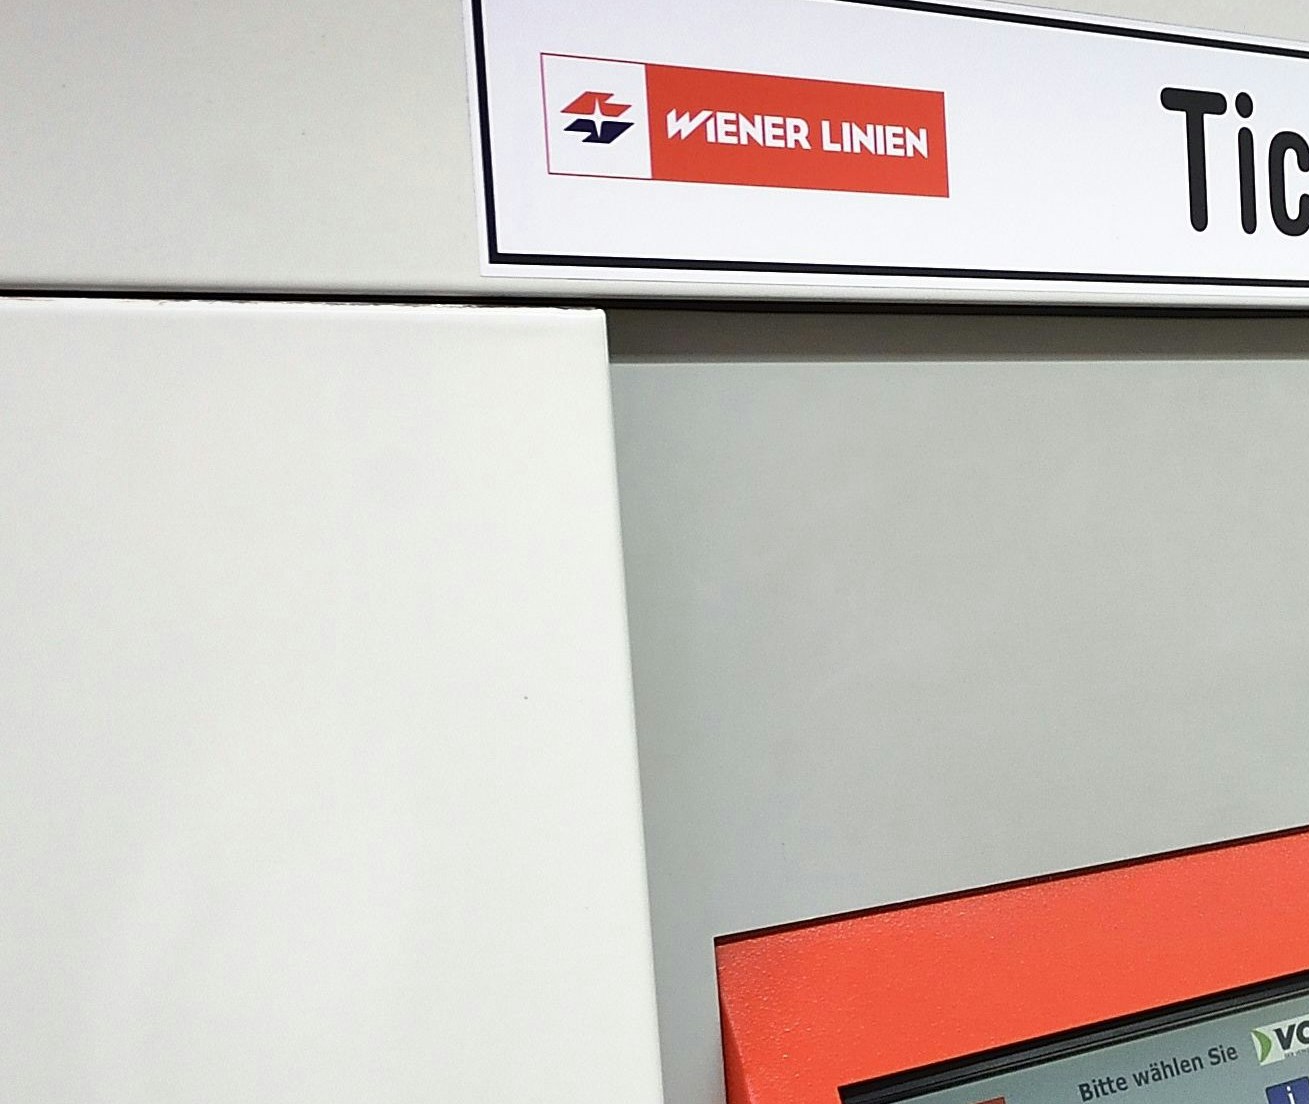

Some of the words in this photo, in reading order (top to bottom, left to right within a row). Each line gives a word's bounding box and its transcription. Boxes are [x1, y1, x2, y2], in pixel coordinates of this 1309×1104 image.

[665, 105, 812, 151] WIENER
[822, 115, 929, 158] LINIEN
[1078, 1074, 1129, 1103] Bitte
[1132, 1054, 1205, 1088] wählen
[1209, 1043, 1239, 1066] Sie
